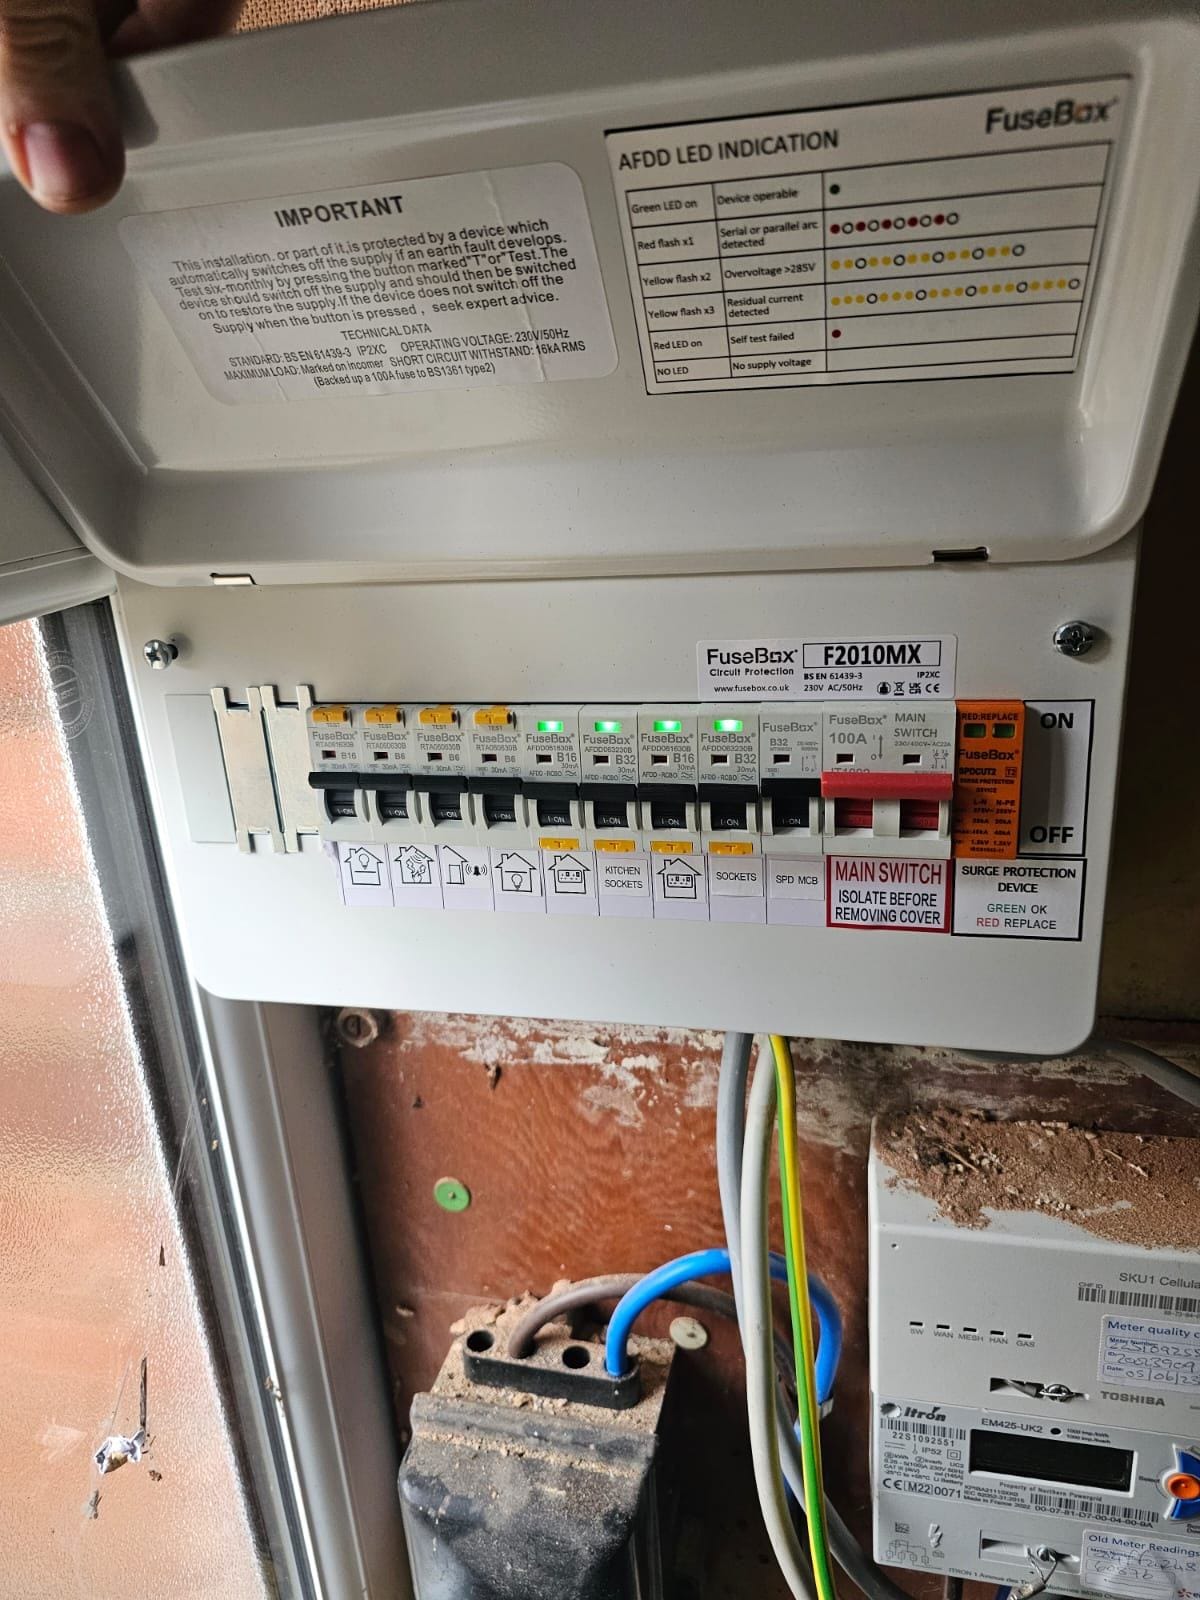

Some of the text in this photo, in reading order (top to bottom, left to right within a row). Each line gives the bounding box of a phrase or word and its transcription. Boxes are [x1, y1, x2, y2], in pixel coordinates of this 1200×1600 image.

[985, 98, 1111, 134] FuseBox
[618, 129, 839, 170] AFDD LED INDICATION
[716, 188, 798, 205] Device operable
[274, 195, 403, 228] IMPORTANT
[631, 200, 698, 214] Green LED on
[719, 220, 818, 237] Serial or parallel arc
[172, 260, 201, 273] This
[277, 250, 290, 261] or
[292, 246, 319, 262] part
[321, 243, 332, 256] of
[362, 232, 426, 254] protected
[428, 231, 445, 246] by
[448, 231, 456, 241] a
[459, 223, 504, 240] device
[507, 218, 550, 234] which
[637, 236, 694, 250] Red flash x1
[721, 238, 765, 250] detected
[724, 262, 816, 280] Overvoltage >285V
[642, 272, 711, 287] Yellow flash x2
[727, 293, 804, 307] Residual current
[212, 319, 254, 334] Supply
[256, 318, 288, 330] when
[290, 315, 310, 327] the
[312, 311, 350, 325] button
[353, 310, 364, 320] is
[432, 299, 464, 312] seek
[466, 295, 508, 311] expert
[511, 291, 560, 306] advice.
[647, 305, 715, 319] Yellow flash x3
[728, 307, 770, 318] detected
[339, 322, 433, 342] TECHNICAL DATA
[730, 331, 795, 344] Self test failed
[400, 327, 570, 353] OPERATING VOLTAGE: 230V/50Hz
[653, 340, 703, 350] Red LED on
[227, 343, 387, 368] STANDARD: BS EN 61439-3 IP2XC
[732, 357, 812, 371] No supply voltage
[657, 366, 688, 376] NO LED
[706, 647, 796, 665] FuseBox
[823, 644, 922, 666] F2010MX
[709, 667, 794, 677] Circuit Protection
[829, 671, 863, 680] 61439-3
[916, 671, 940, 679] IP2XC
[713, 684, 790, 693] www.fusebox.co.uk
[803, 683, 863, 692] 230V AC/50Hz
[829, 714, 883, 725] FuseBox
[894, 713, 926, 723] MAIN
[1039, 712, 1074, 729] ON
[762, 722, 814, 733] FuseBox
[893, 728, 938, 738] SWITCH
[312, 731, 355, 741] FuseBox
[363, 731, 407, 742] FuseBox
[417, 732, 461, 743] FuseBox
[472, 733, 517, 744] FuseBox
[526, 734, 571, 744] FuseBox
[583, 734, 630, 745] FuseBox
[640, 733, 690, 743] FuseBox
[700, 733, 752, 743] FuseBox
[829, 733, 868, 745] 100A
[770, 737, 788, 747] B32
[394, 752, 406, 760] B6
[448, 753, 460, 761] B6
[504, 755, 516, 763] B6
[557, 752, 577, 762] B16
[615, 754, 636, 765] B32
[673, 753, 694, 763] B16
[734, 753, 757, 764] B32
[1029, 826, 1074, 844] OFF
[605, 865, 640, 875] KITCHEN
[835, 861, 942, 885] MAIN SWITCH
[961, 865, 1076, 878] SURGE PROTECTION
[716, 871, 757, 882] SOCKETS
[775, 874, 818, 885] SPD MCB
[604, 879, 643, 889] SOCKETS
[997, 882, 1038, 893] DEVICE
[838, 889, 937, 907] ISOLATE BEFORE
[987, 903, 1048, 914] GREEN OK
[835, 907, 941, 925] REMOVING COVER
[976, 917, 1057, 930] RED REPLACE
[1118, 1272, 1155, 1285] SKU1
[933, 1330, 954, 1339] WAN
[1107, 1320, 1145, 1333] Meter
[1147, 1324, 1190, 1339] quality
[958, 1333, 984, 1342] MESH
[988, 1336, 1008, 1345] HAN
[1015, 1340, 1035, 1348] GAS
[1100, 1391, 1166, 1407] TOSHIBA
[903, 1407, 947, 1422] Itron
[981, 1418, 1044, 1434] EM425-UK2
[891, 1431, 955, 1447] 22S1092551
[1088, 1535, 1200, 1558] Old Meter Readings
